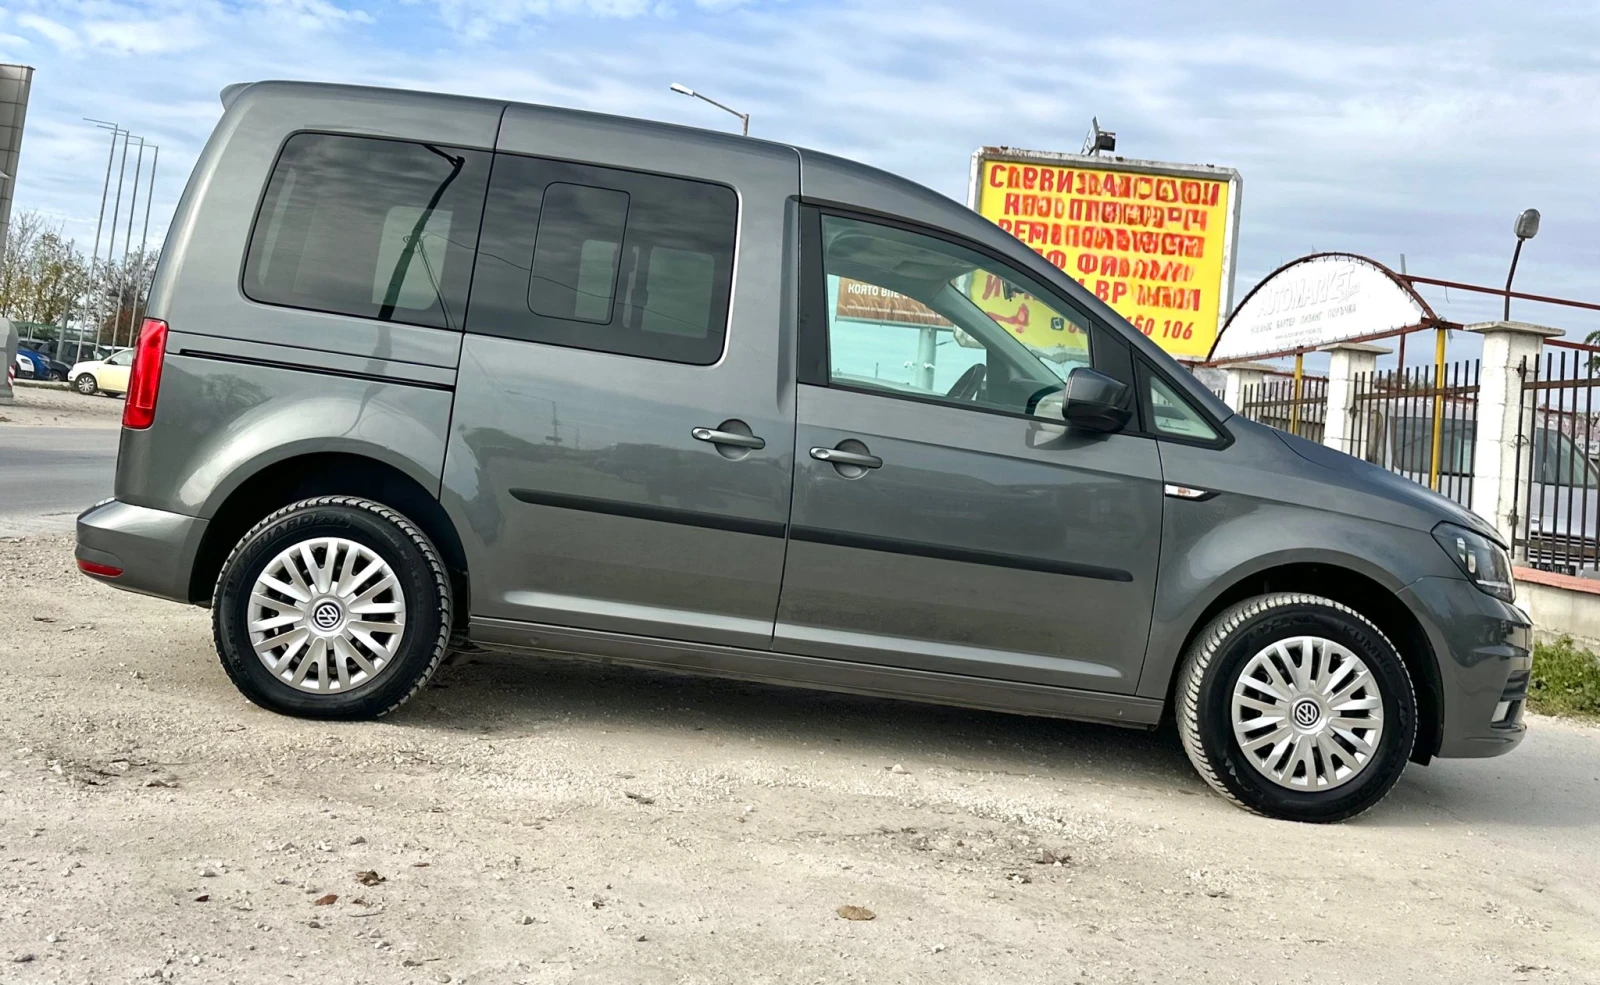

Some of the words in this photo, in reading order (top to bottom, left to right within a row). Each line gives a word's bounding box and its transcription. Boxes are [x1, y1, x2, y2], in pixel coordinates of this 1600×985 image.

[848, 283, 878, 296] КОЯТО
[1256, 264, 1355, 317] AUTOMARKET
[1276, 317, 1296, 329] БАРТЕР
[1327, 303, 1356, 318] ПОРЪЧКА
[1163, 320, 1194, 340] 106
[1341, 624, 1396, 674] KUMHO
